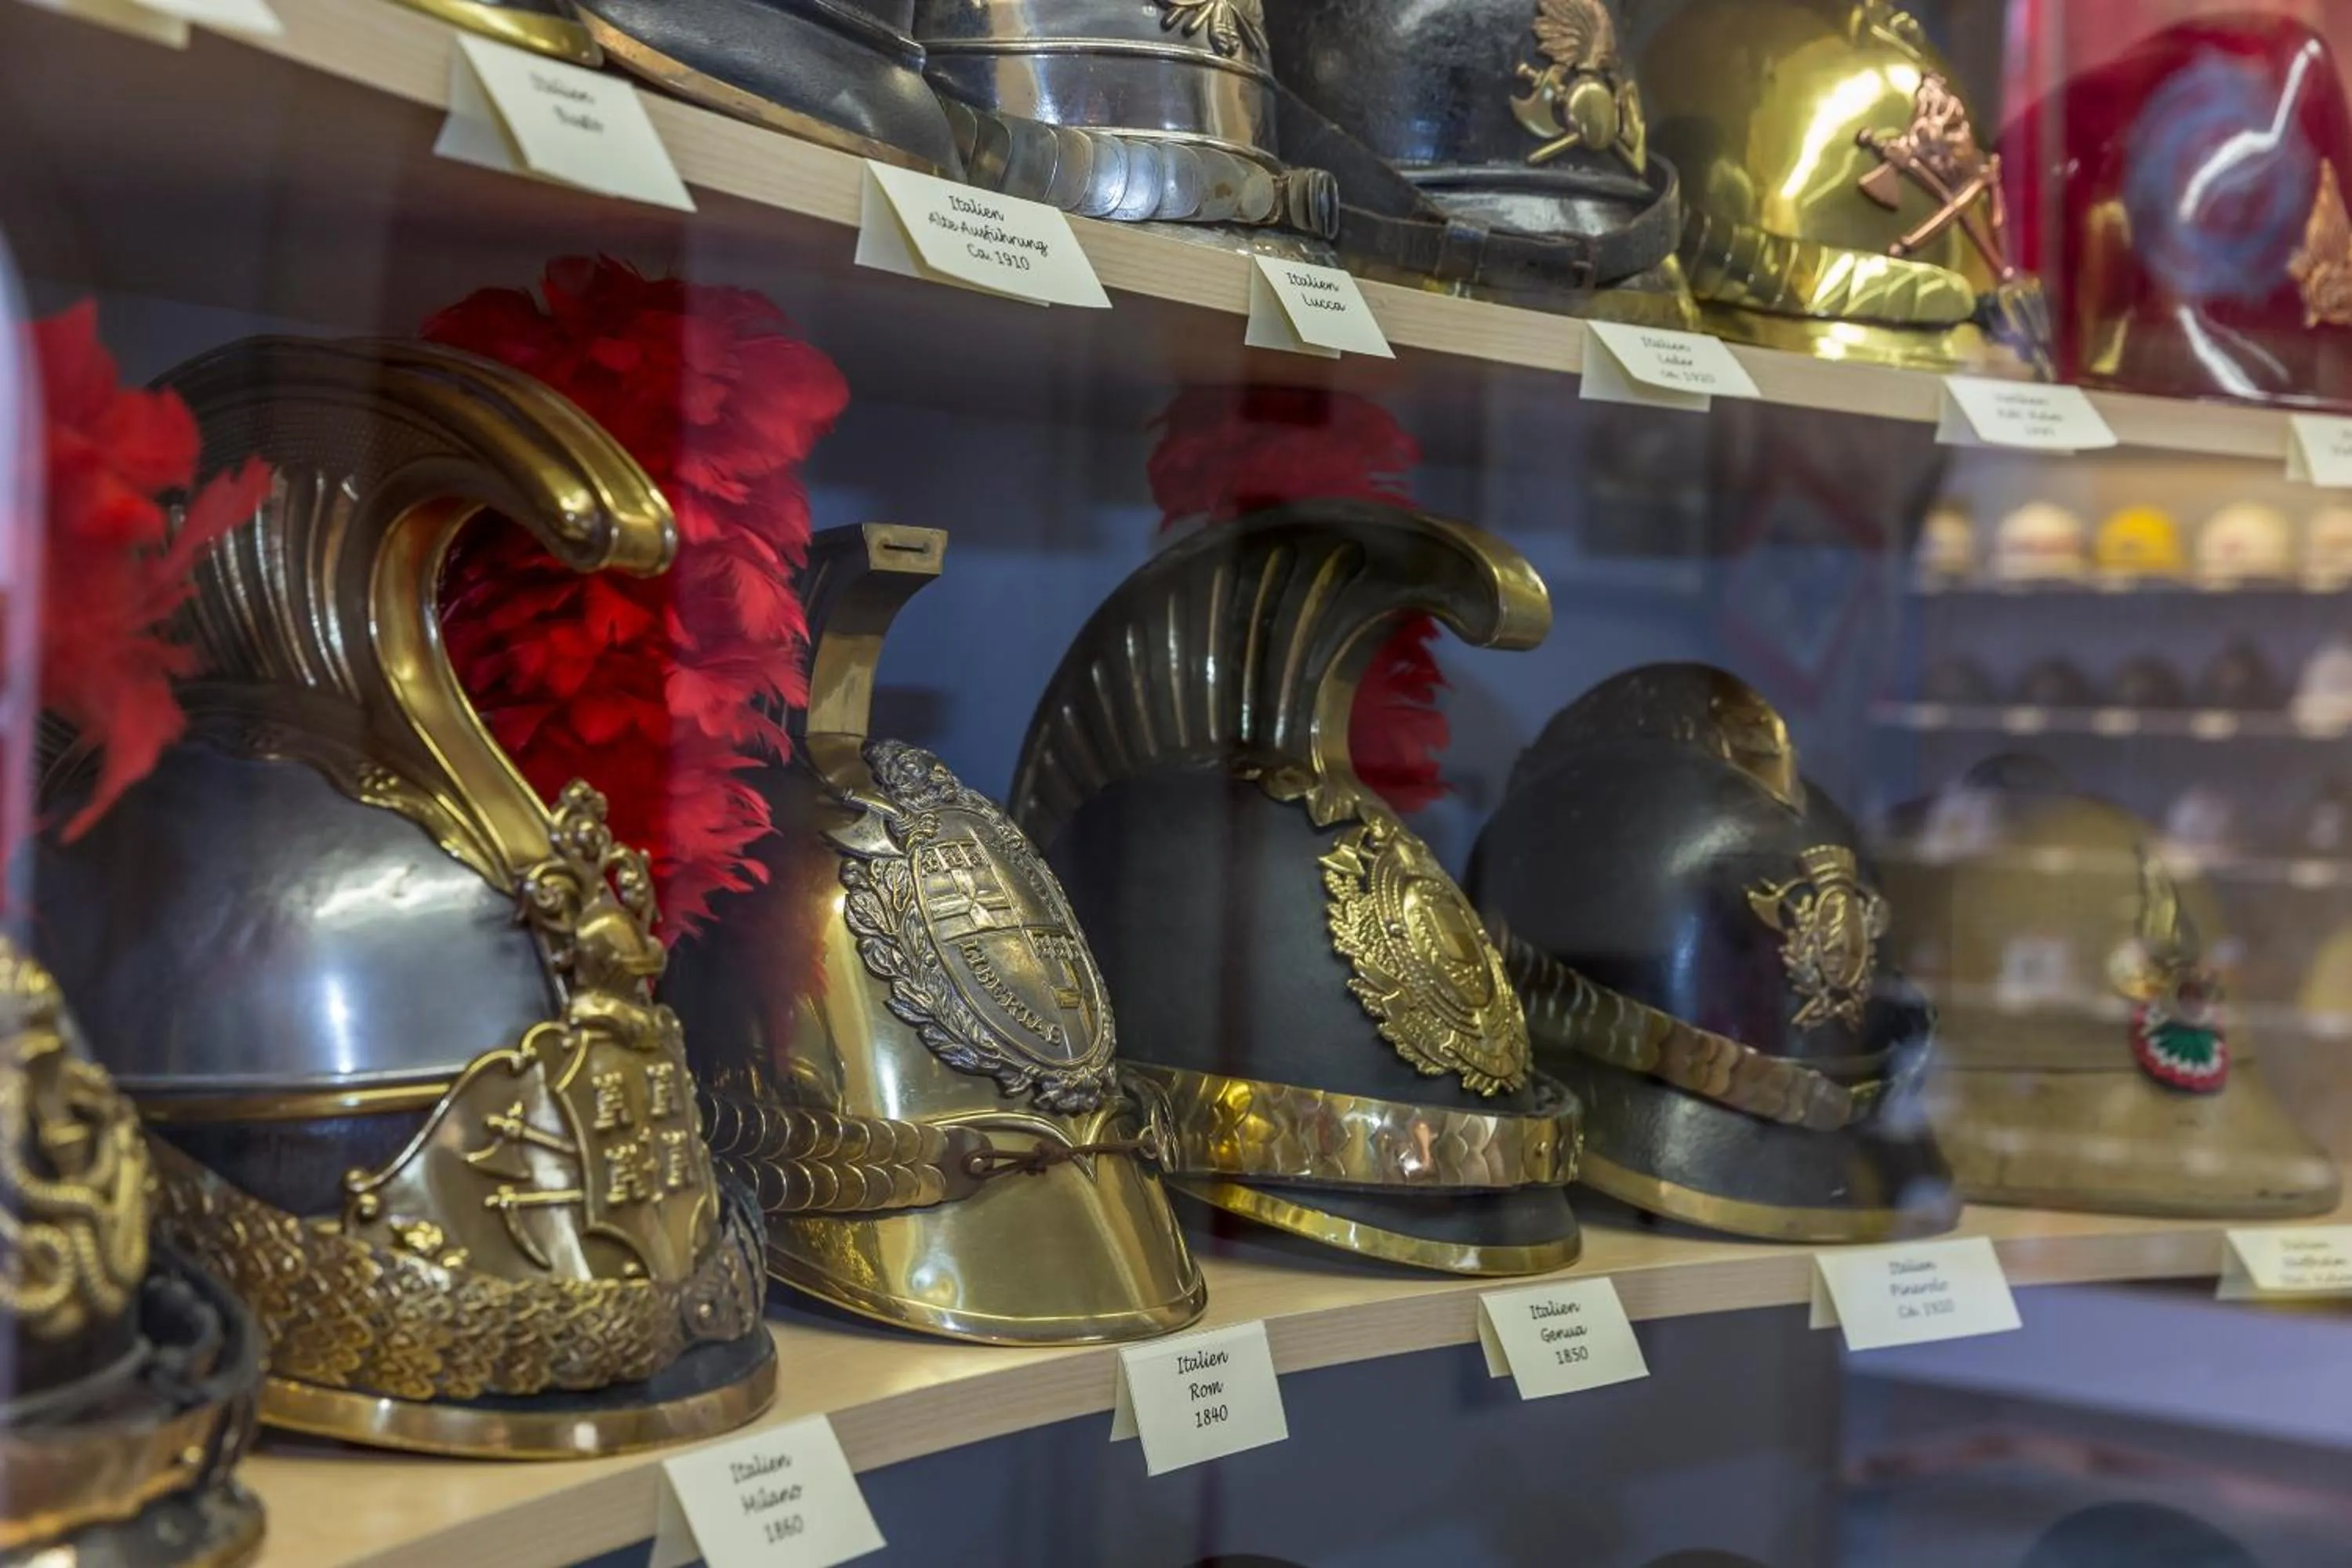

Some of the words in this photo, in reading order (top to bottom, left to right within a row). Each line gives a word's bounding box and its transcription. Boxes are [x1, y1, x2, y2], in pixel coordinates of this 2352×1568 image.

[948, 194, 1005, 223] Italien
[994, 250, 1030, 271] 1910
[1286, 271, 1339, 292] Italien
[1301, 292, 1346, 311] Lucca
[1530, 1300, 1581, 1320] Italien
[1540, 1324, 1588, 1343] Genua
[1176, 1349, 1229, 1374] Italien
[1555, 1345, 1589, 1365] 1850
[1189, 1380, 1224, 1401] Rom
[1195, 1404, 1229, 1428] 1840
[729, 1454, 793, 1484] Italien
[740, 1483, 803, 1515] Milano
[763, 1514, 804, 1544] 1860
